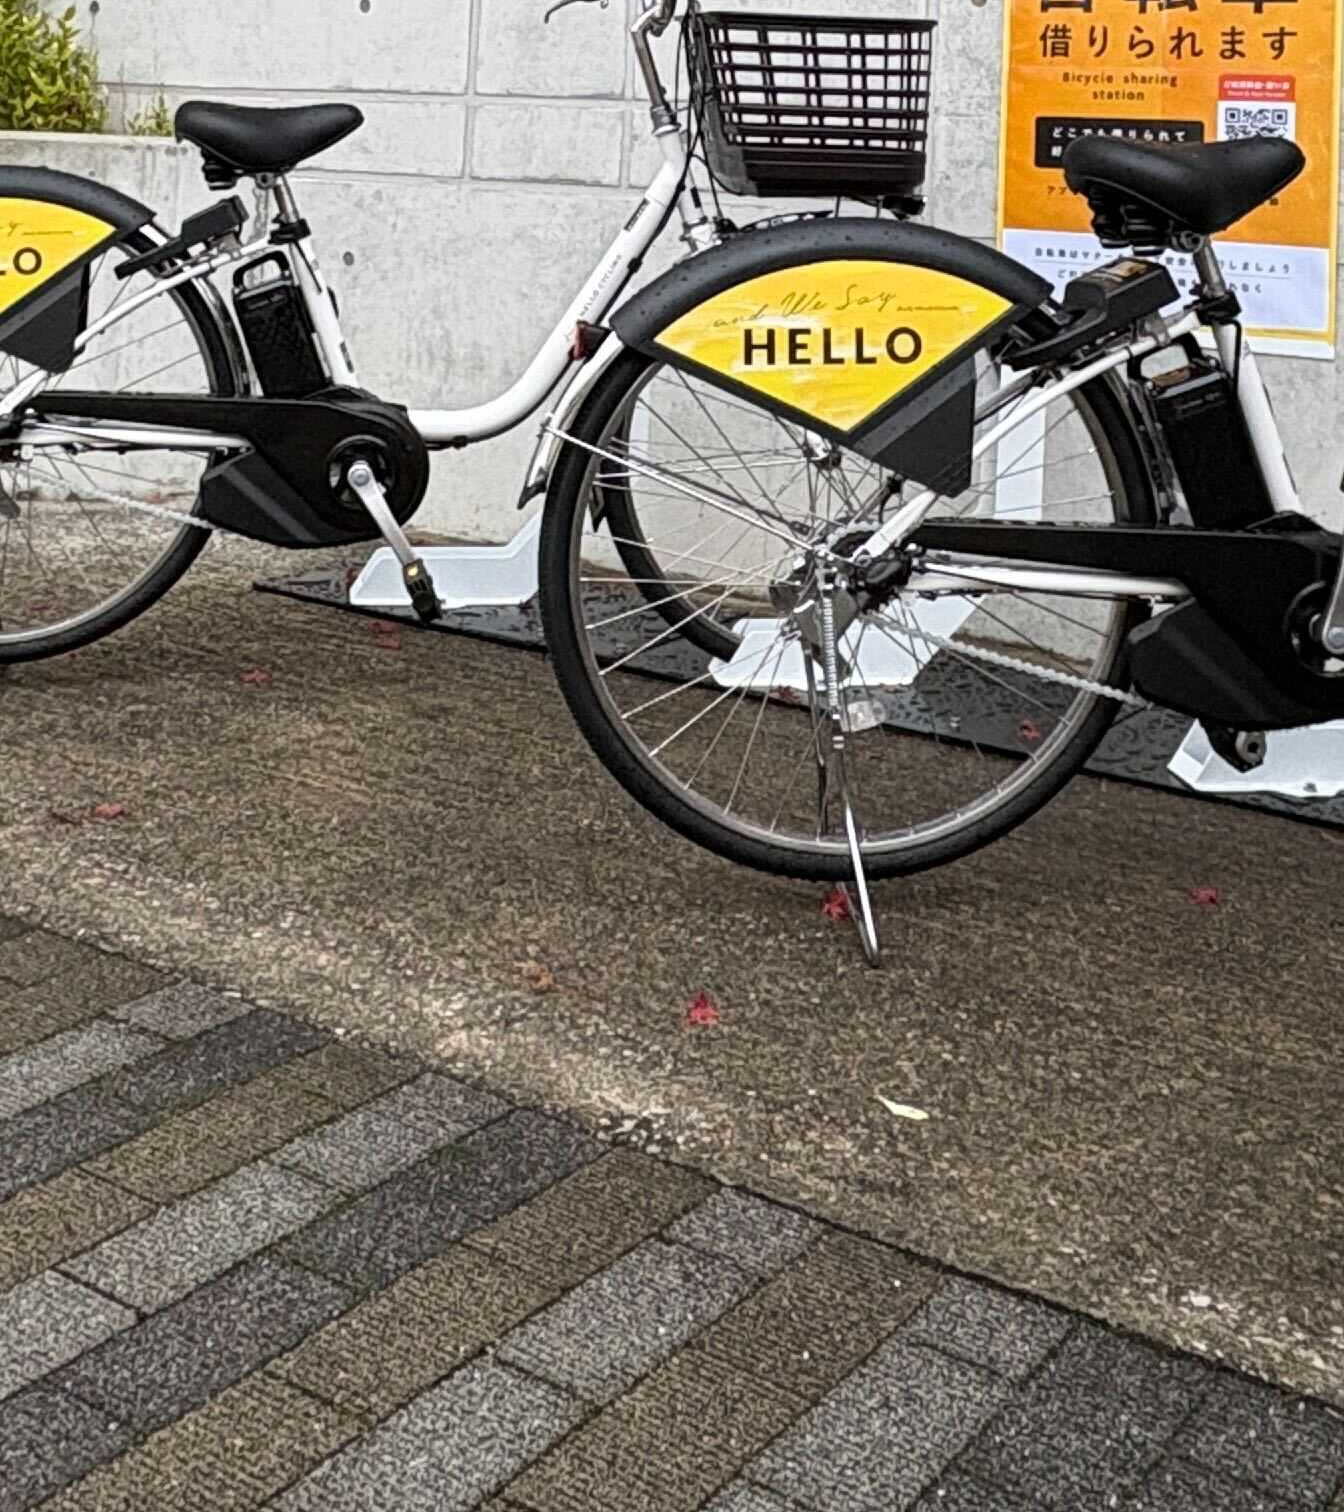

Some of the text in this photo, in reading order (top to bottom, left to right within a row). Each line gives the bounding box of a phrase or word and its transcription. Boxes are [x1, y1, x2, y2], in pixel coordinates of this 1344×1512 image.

[1040, 23, 1298, 60] 借りられます
[1062, 72, 1178, 87] Bicycle sharing
[1092, 89, 1145, 101] station
[780, 291, 827, 318] We
[835, 284, 896, 312] Say
[744, 326, 922, 365] HELLO
